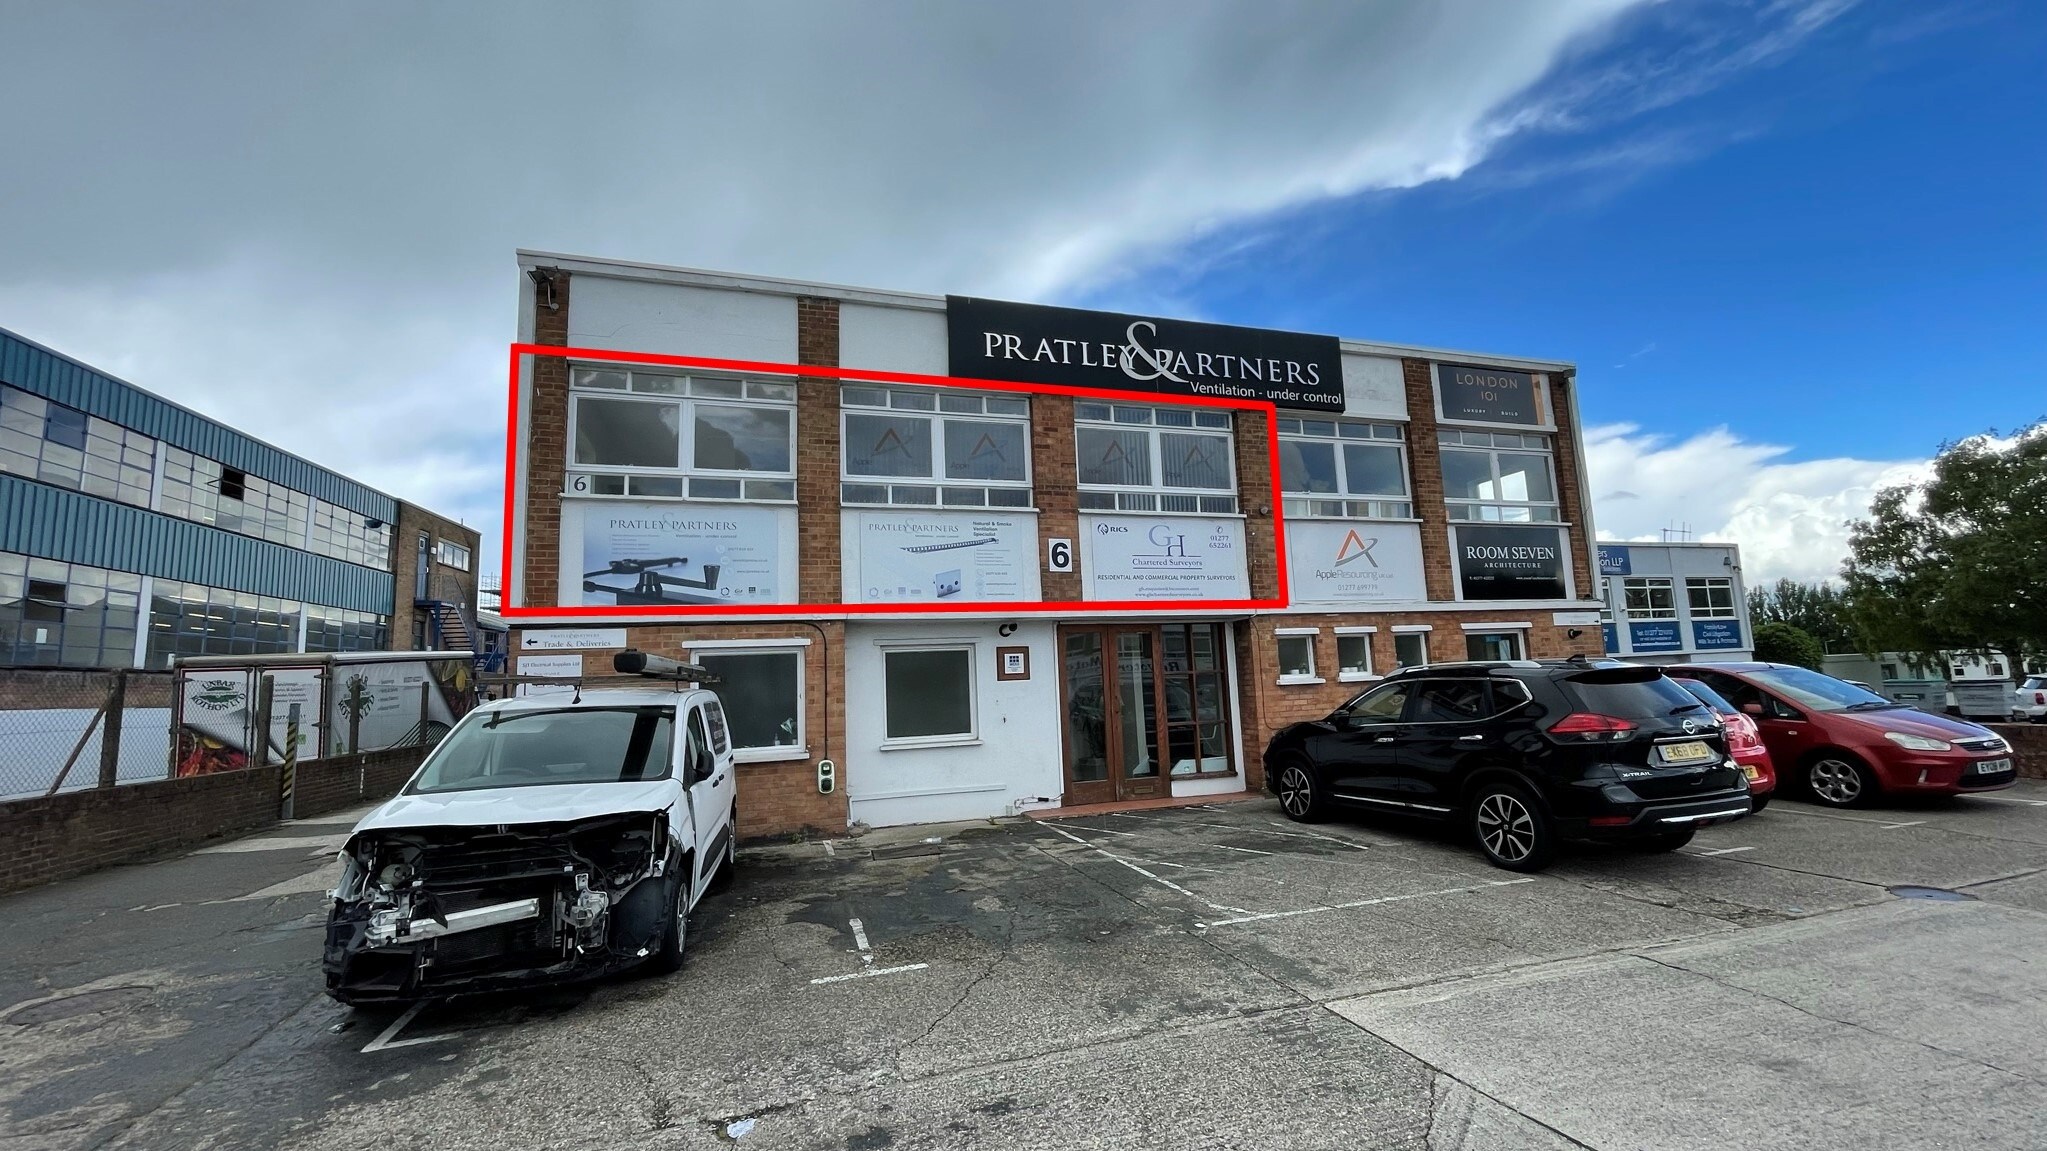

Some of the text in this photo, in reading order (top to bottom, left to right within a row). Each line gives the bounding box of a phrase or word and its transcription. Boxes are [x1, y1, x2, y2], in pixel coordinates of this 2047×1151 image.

[983, 331, 1140, 370] PRATLEY
[1153, 347, 1321, 387] PARTNERS
[1456, 373, 1518, 389] LONDON
[1190, 380, 1256, 398] Ventilation
[1266, 389, 1301, 402] under
[1303, 391, 1343, 405] control
[574, 476, 587, 492] 6
[610, 519, 666, 530] PRATLEY
[672, 520, 738, 531] PARTNERS
[868, 523, 908, 533] PRATLEY
[912, 524, 959, 533] PARTNERS
[1051, 542, 1070, 568] 6
[1466, 546, 1555, 560] ROOM SEVEN
[1132, 558, 1203, 568] Chartered Surveyors
[1612, 558, 1624, 567] LLP
